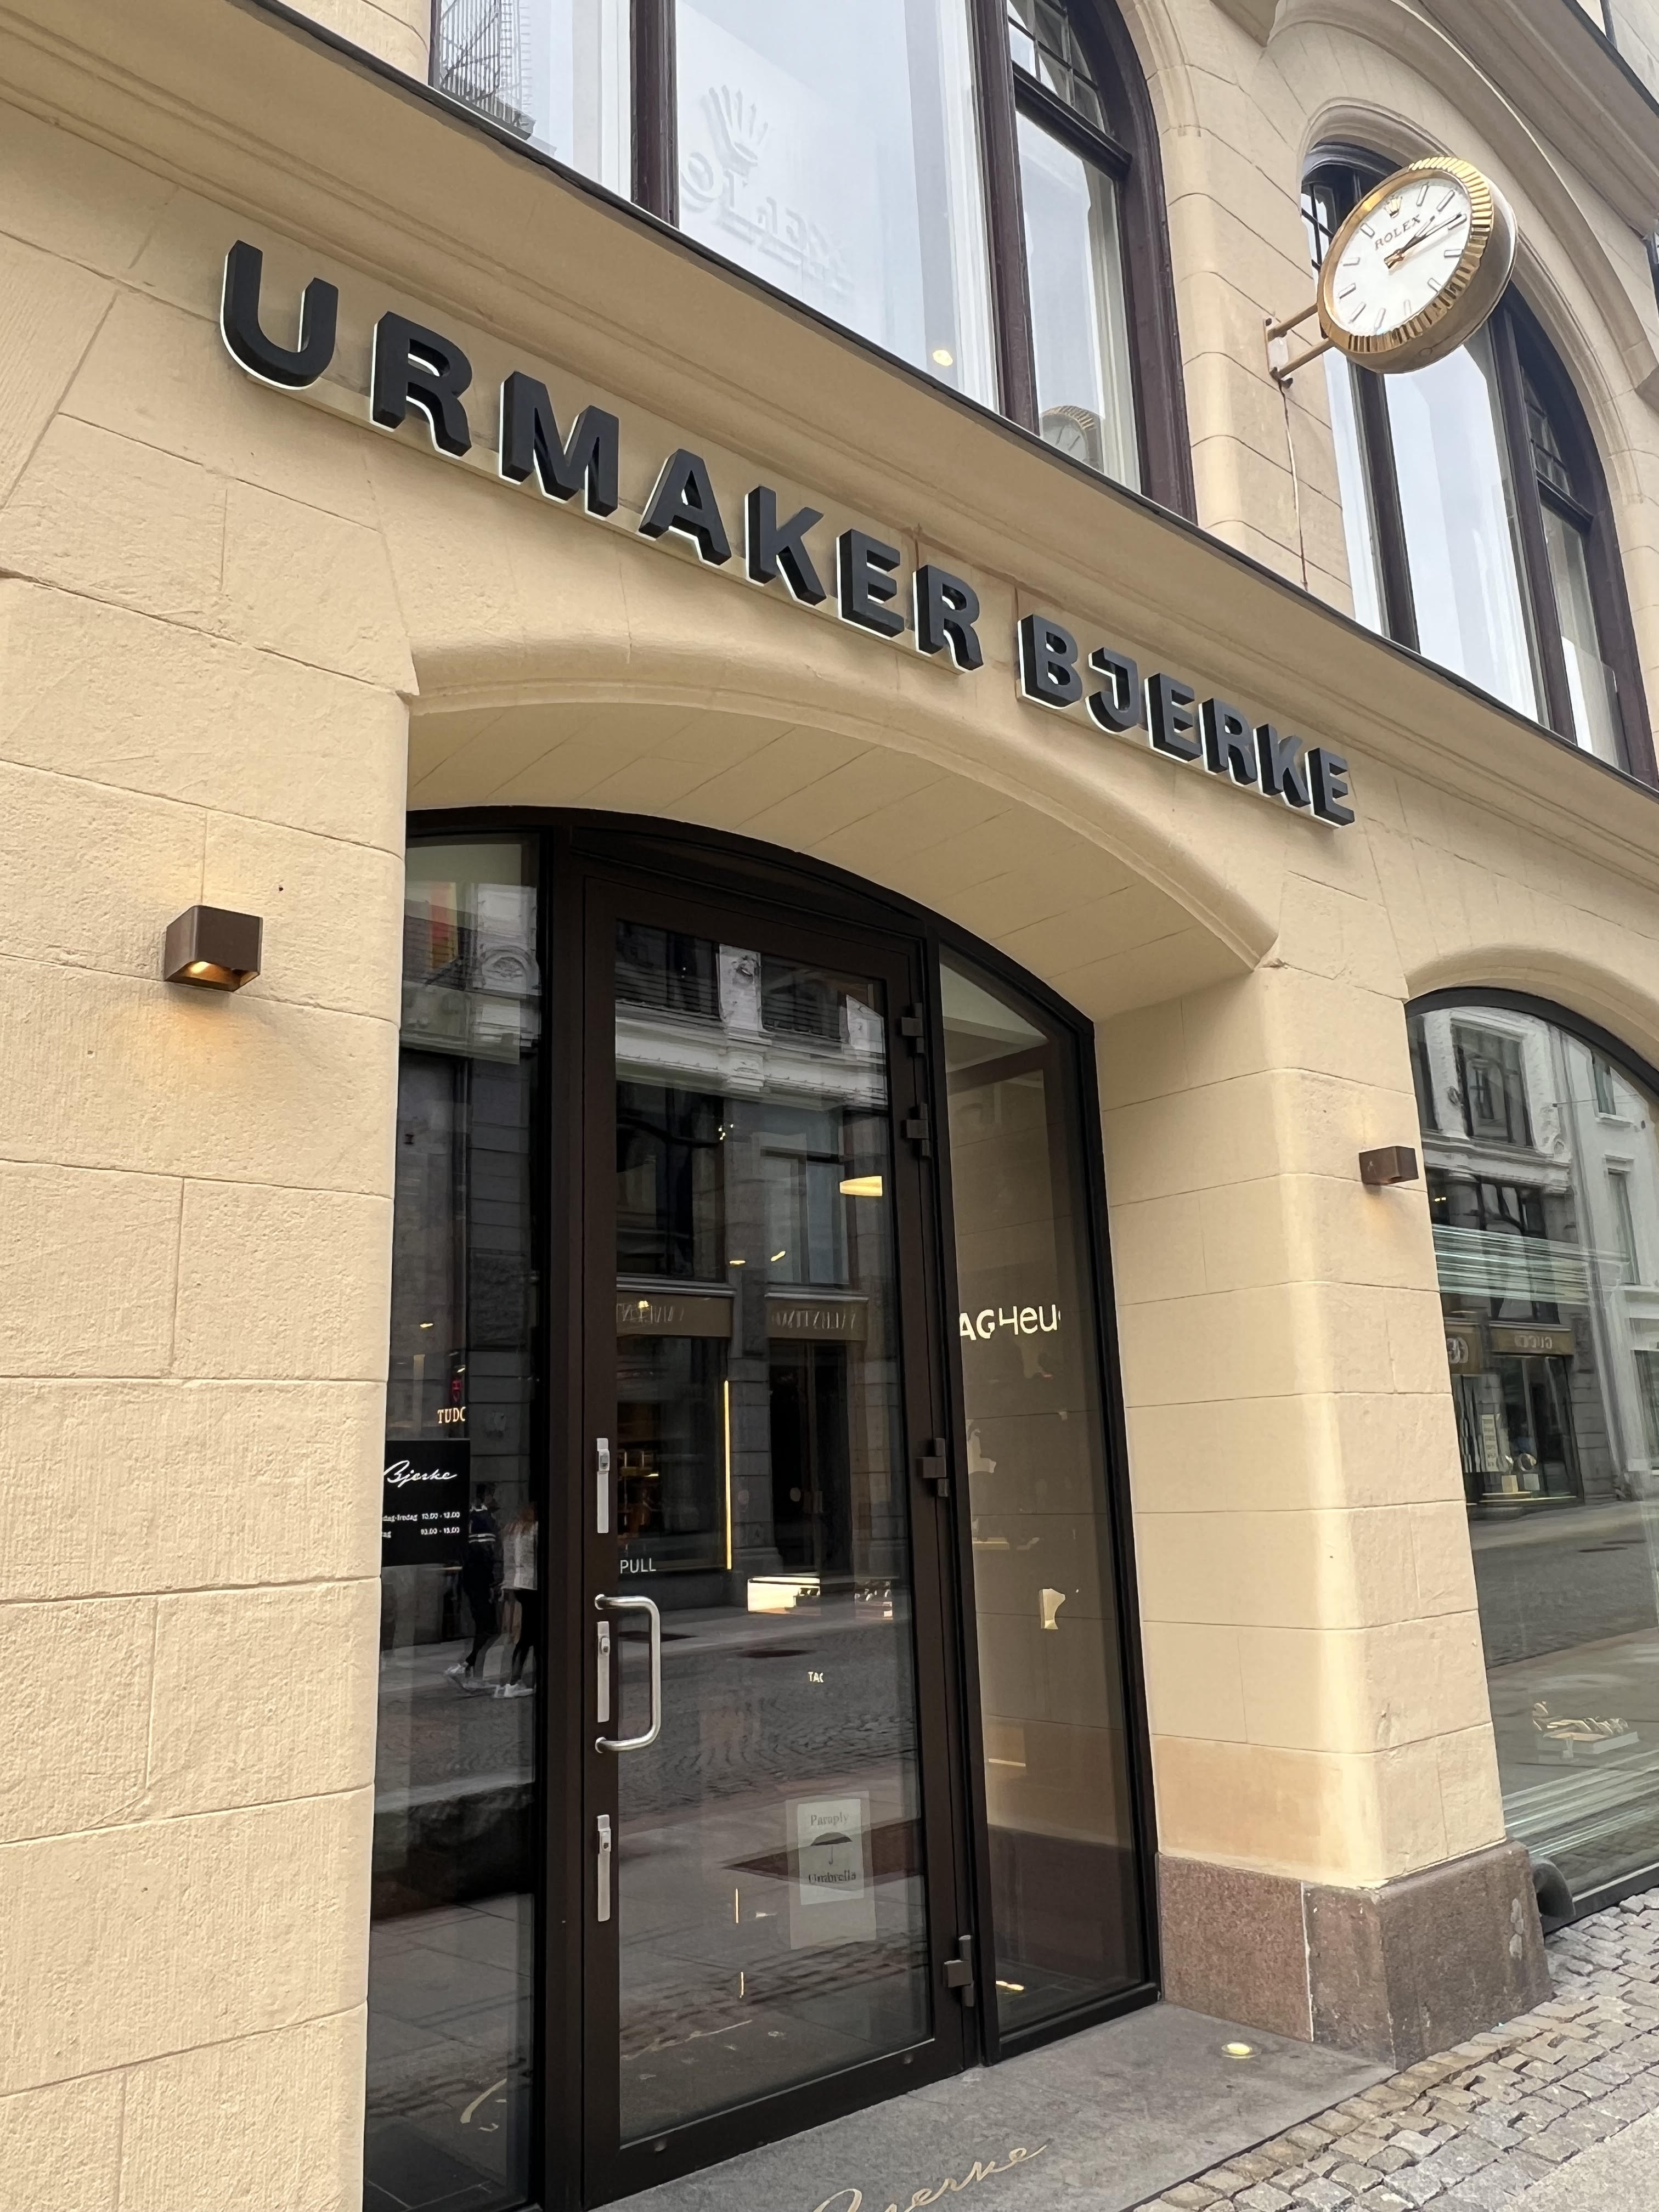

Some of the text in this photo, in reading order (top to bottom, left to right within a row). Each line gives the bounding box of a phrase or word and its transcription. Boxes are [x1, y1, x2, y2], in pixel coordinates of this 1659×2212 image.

[1375, 214, 1420, 250] ROLEX
[220, 239, 1355, 829] URMAKER BJERKE
[383, 1460, 458, 1487] Bjerke
[620, 1558, 657, 1574] PULL
